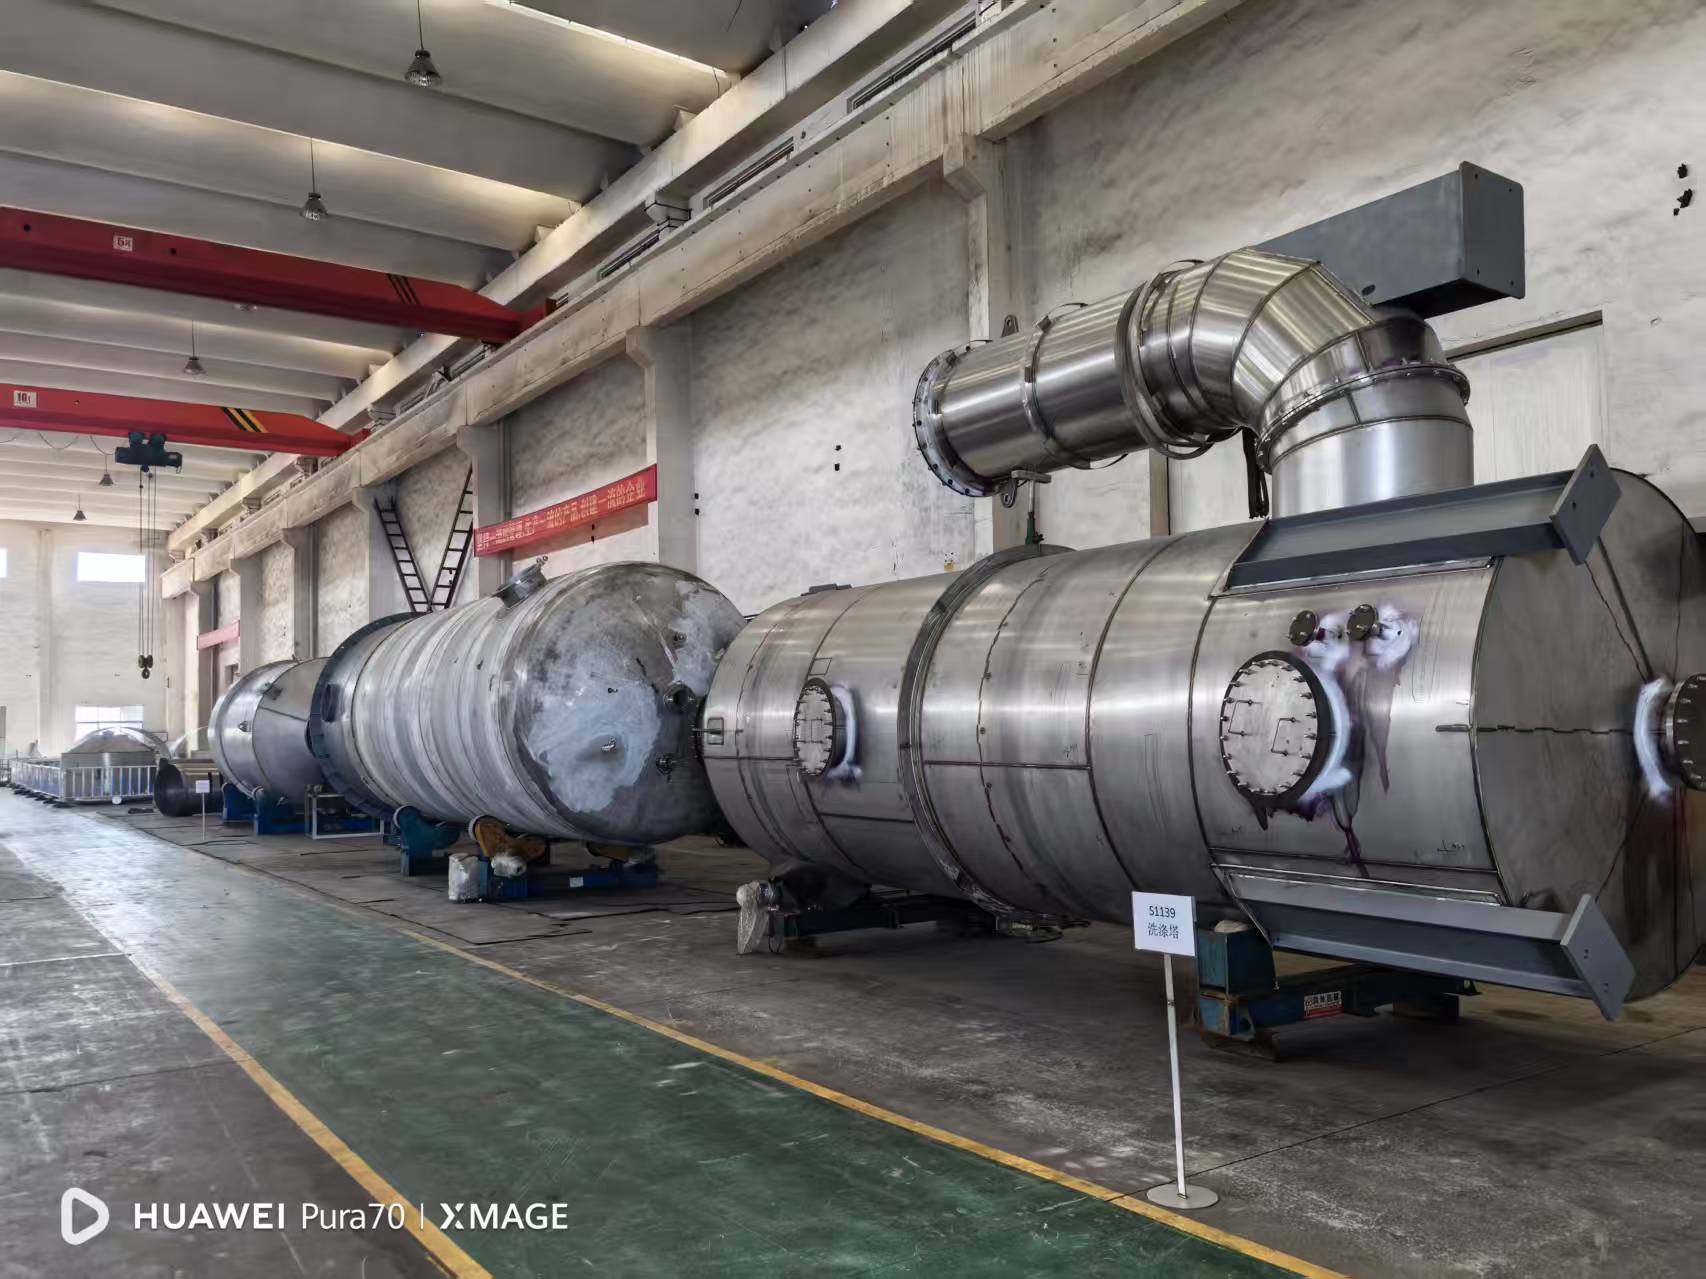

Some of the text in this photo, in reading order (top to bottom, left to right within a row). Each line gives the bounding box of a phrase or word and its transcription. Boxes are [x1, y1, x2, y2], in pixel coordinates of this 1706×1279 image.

[1149, 905, 1176, 919] S1139
[1148, 922, 1179, 939] 洗涤塔
